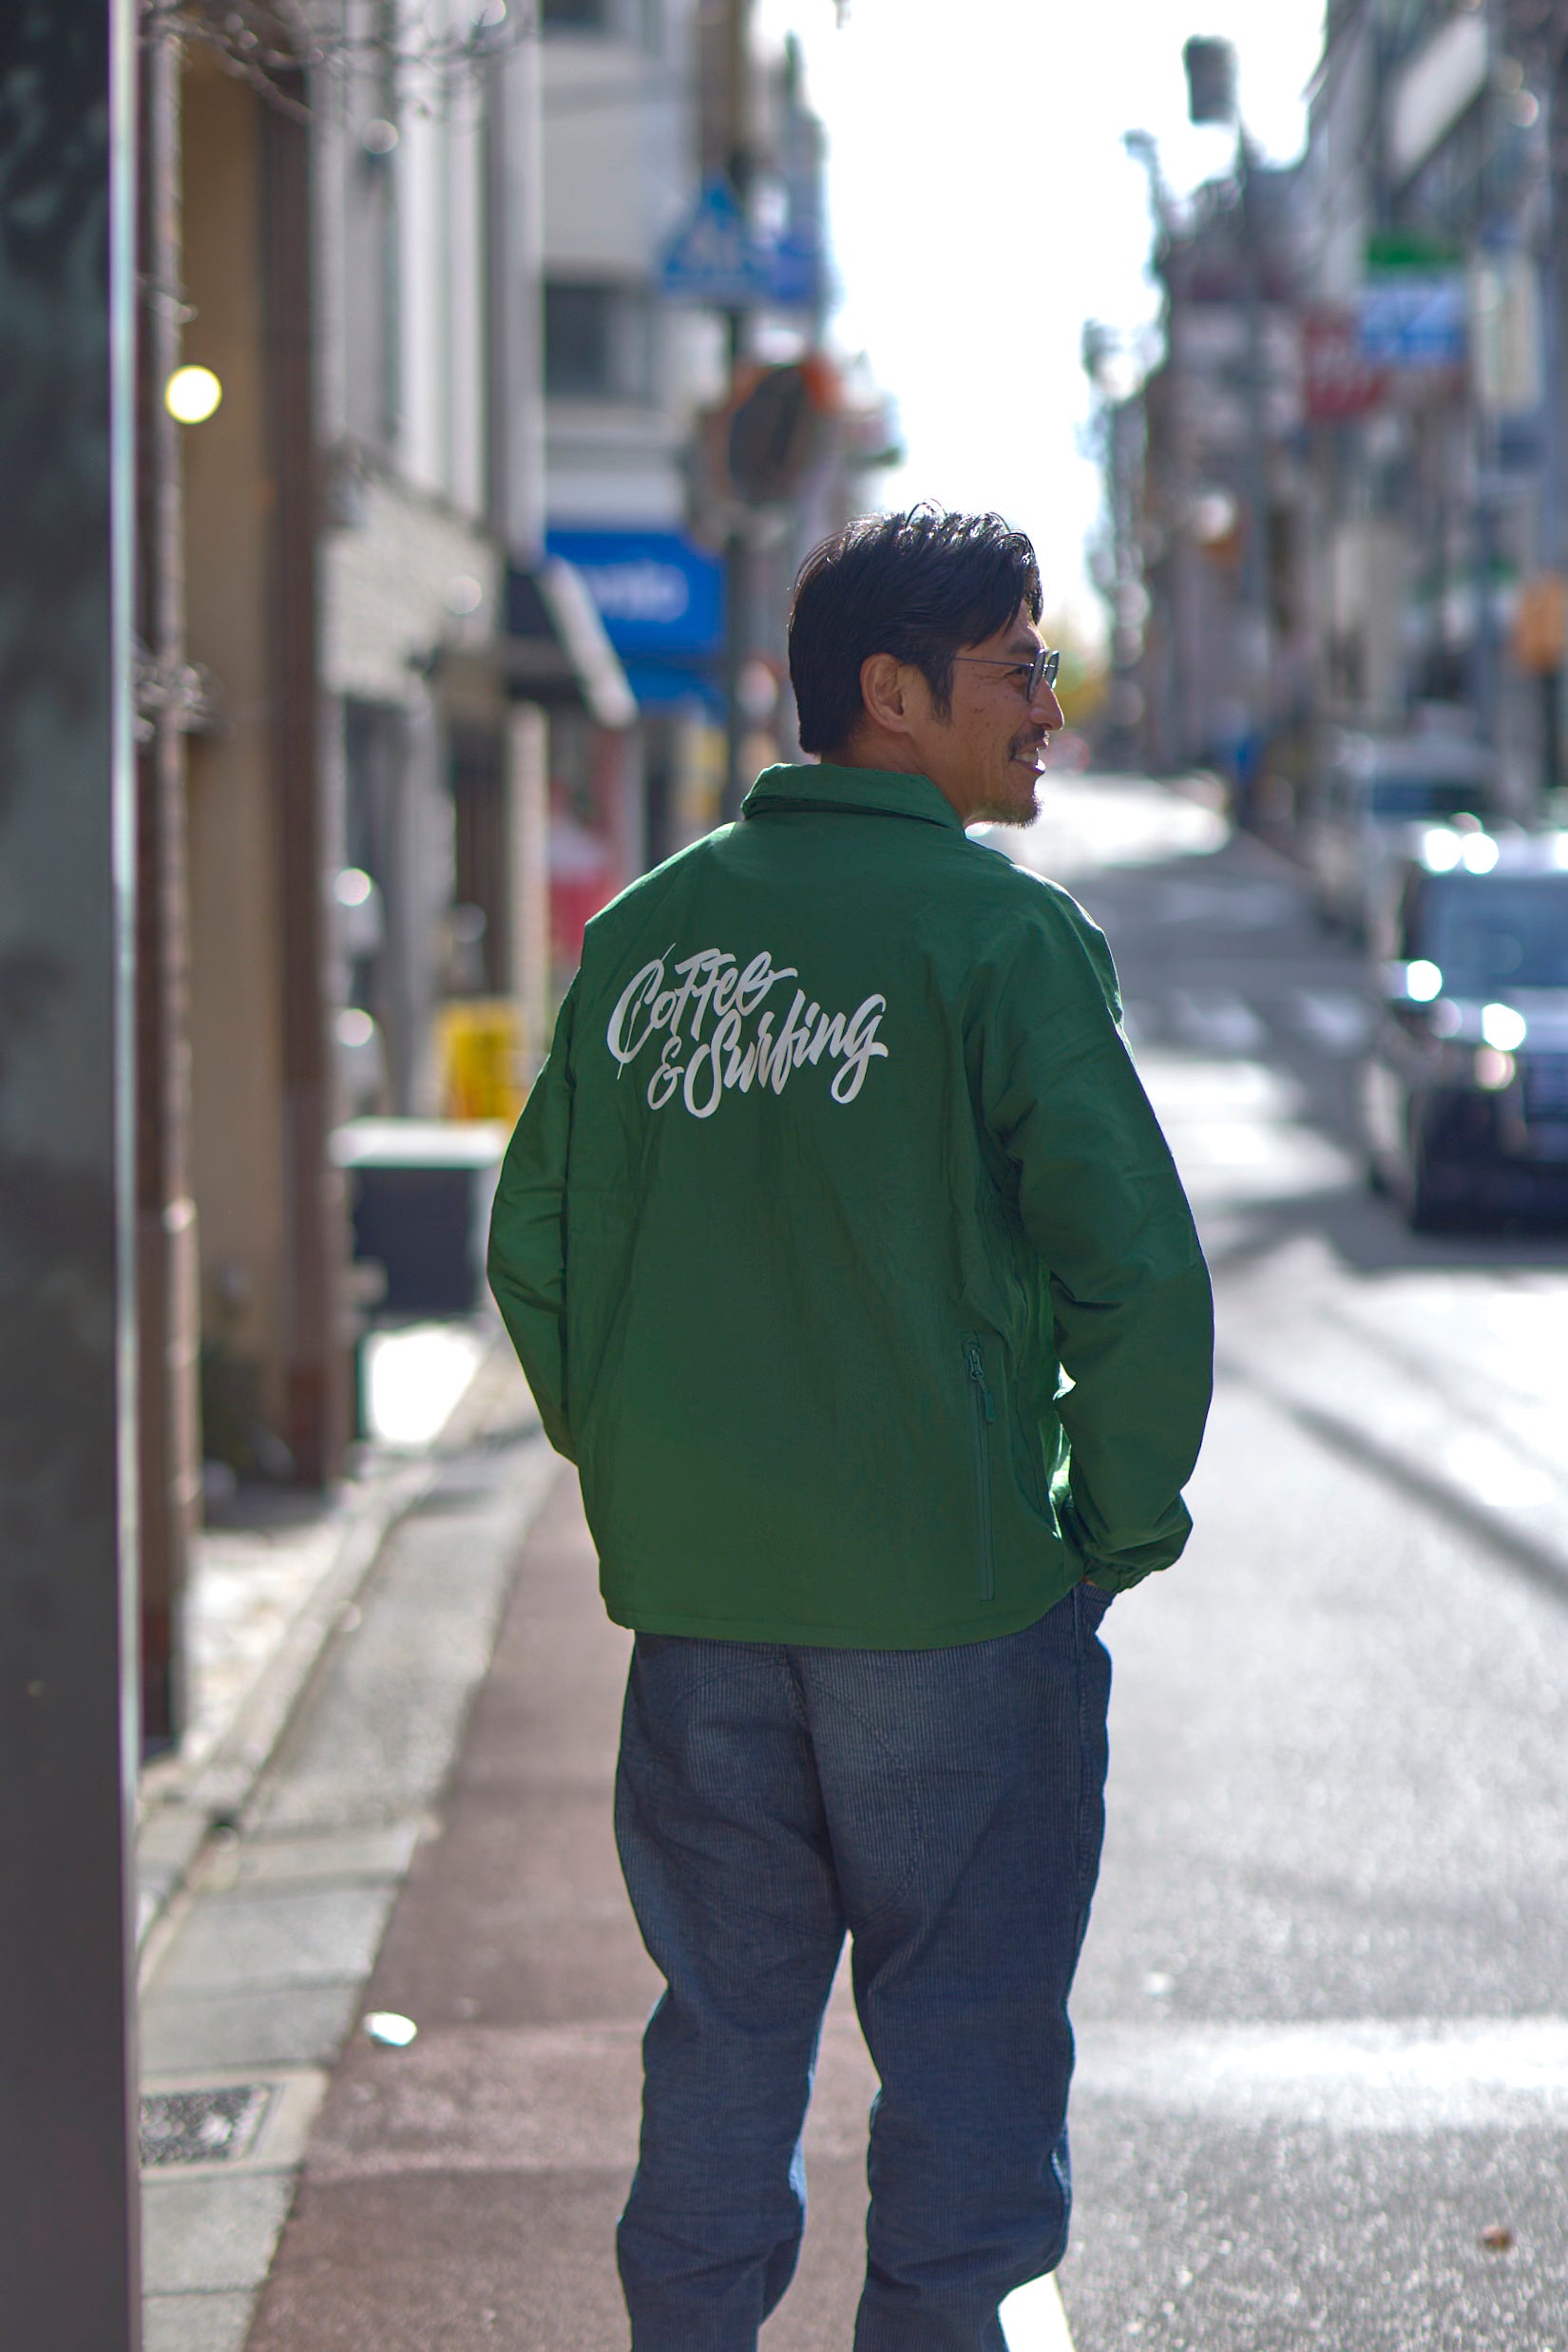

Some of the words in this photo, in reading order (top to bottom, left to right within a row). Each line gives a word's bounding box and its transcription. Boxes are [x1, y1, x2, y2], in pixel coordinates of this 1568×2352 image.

[607, 943, 798, 1080] Coffee
[647, 1036, 684, 1110] &
[683, 988, 889, 1119] Surfing
